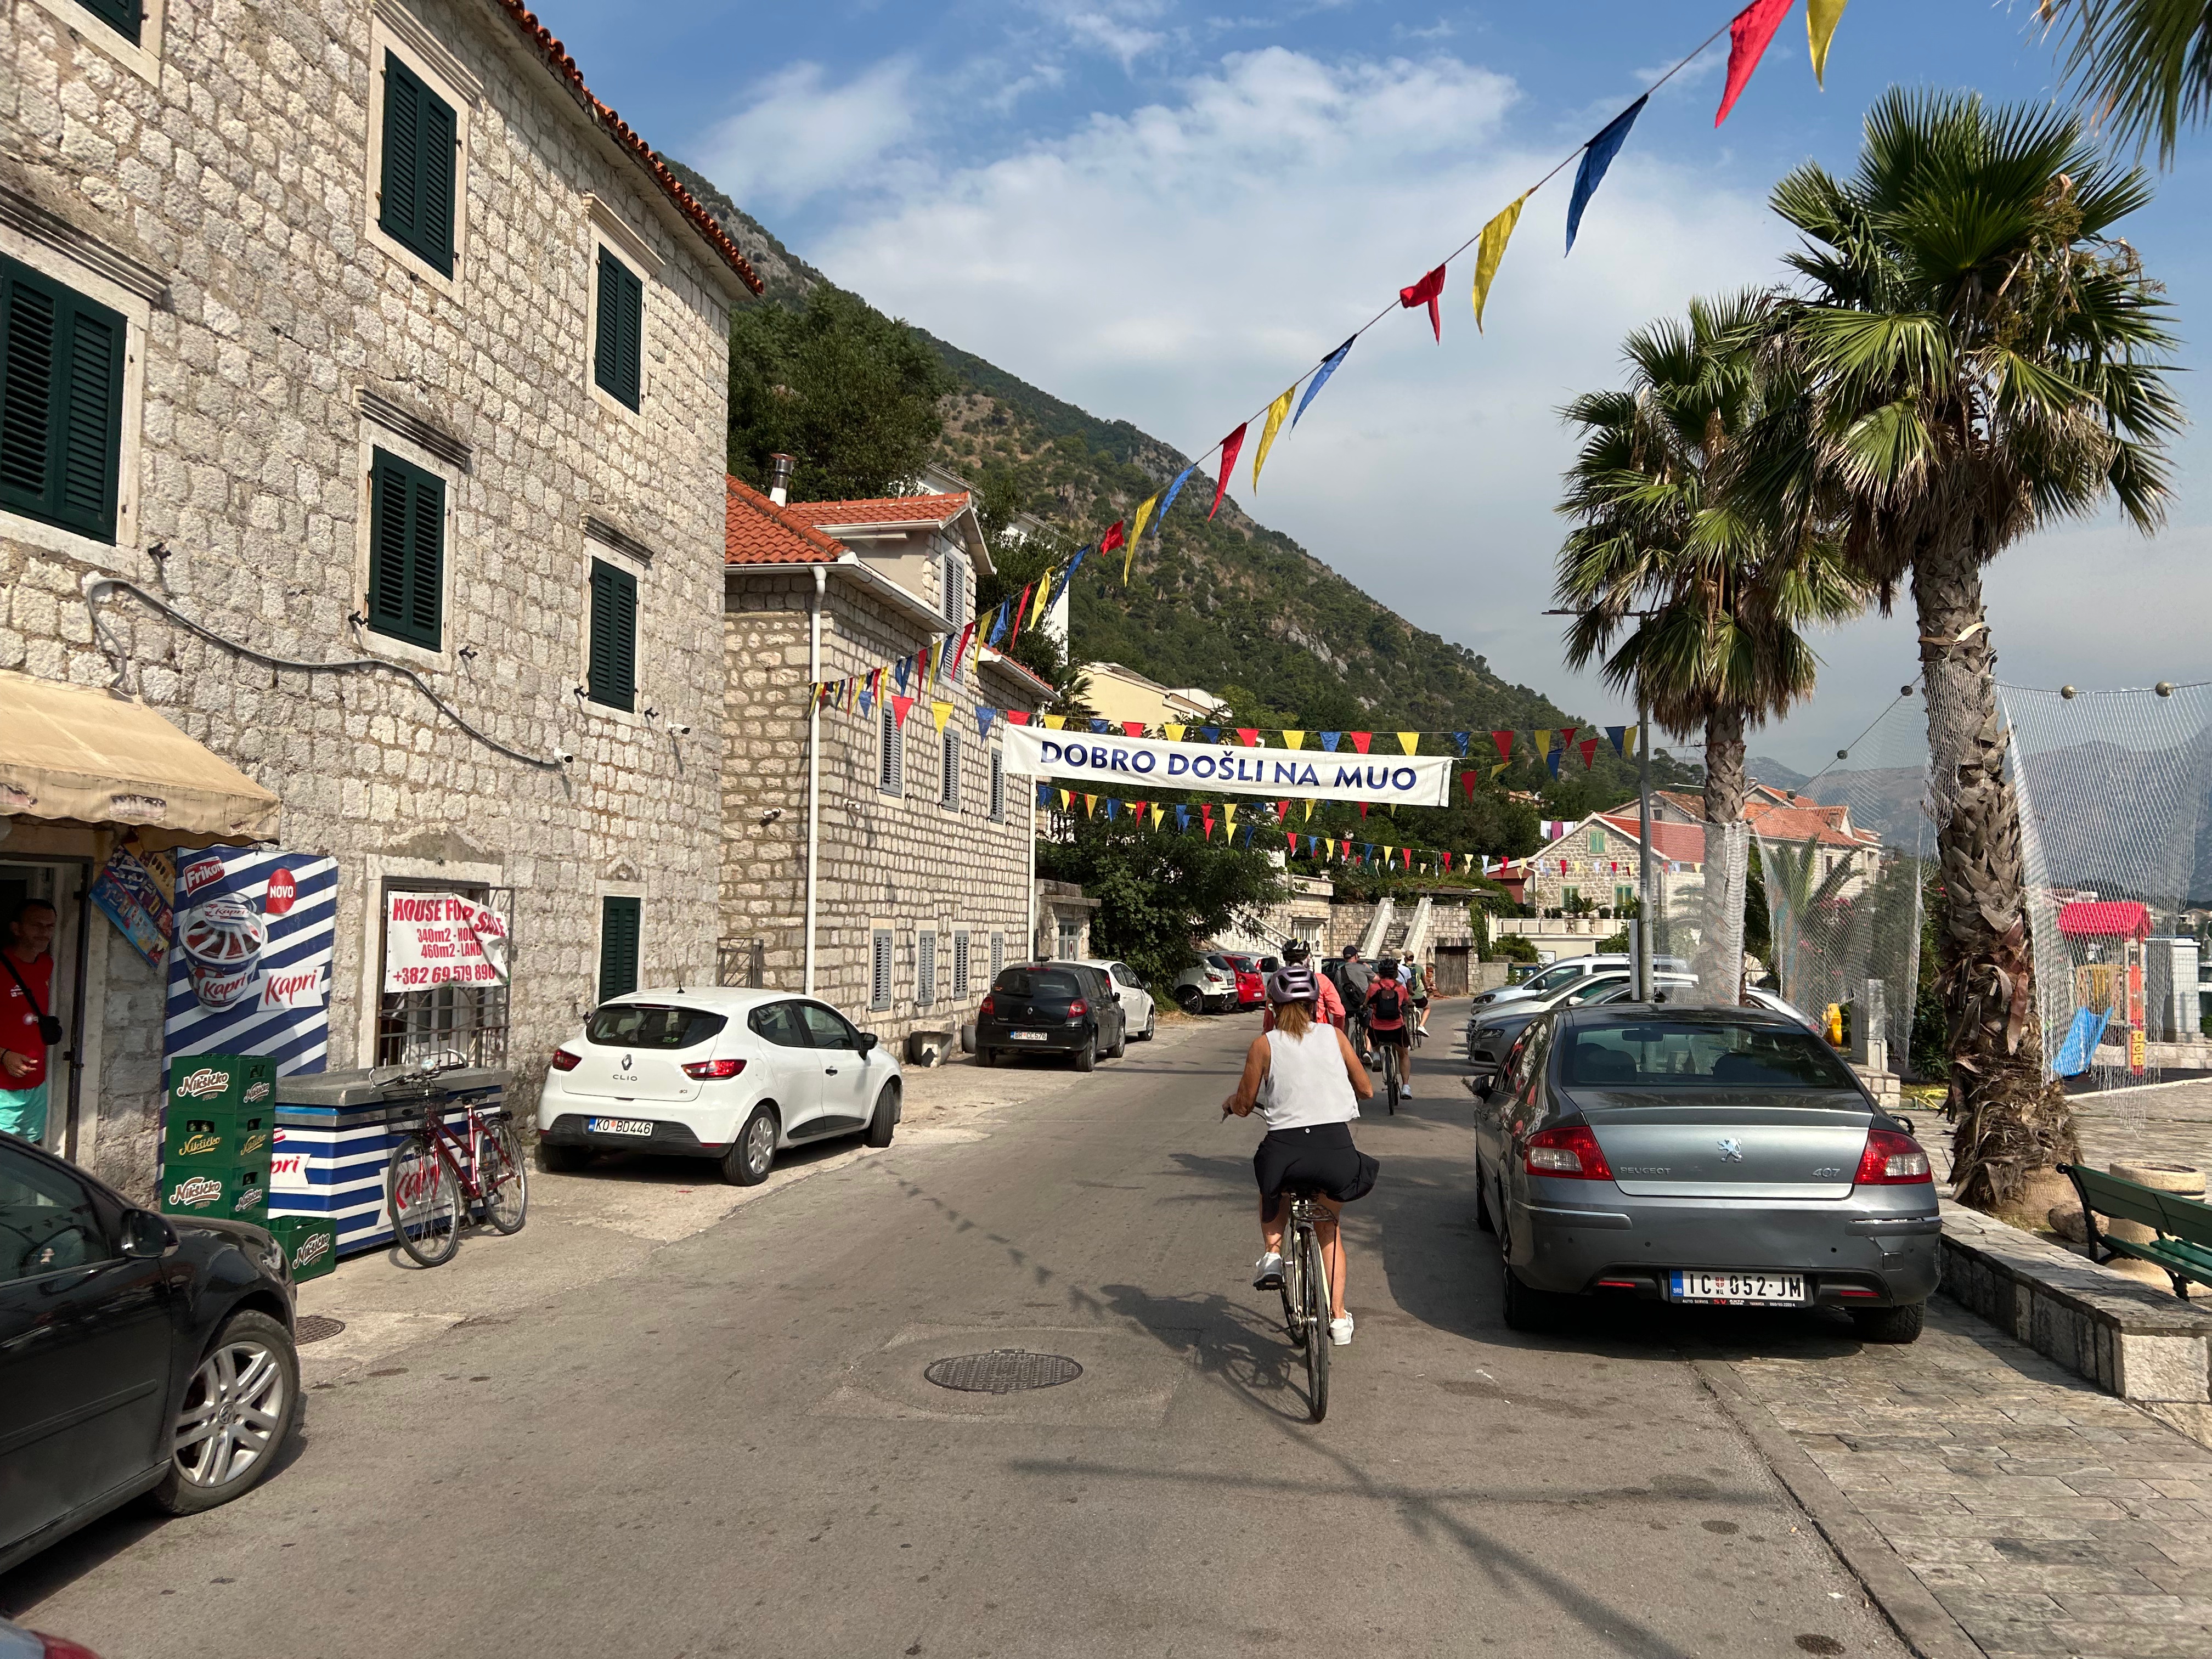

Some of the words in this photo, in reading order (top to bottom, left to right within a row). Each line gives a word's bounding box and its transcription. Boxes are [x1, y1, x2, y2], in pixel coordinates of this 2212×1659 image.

[1041, 741, 1156, 774] DOBRO
[1167, 751, 1263, 782] DOŠLI
[1274, 761, 1320, 786] NA
[1334, 765, 1417, 791] MUO
[270, 885, 294, 899] NOVO
[393, 898, 443, 922] HOUSE
[445, 899, 475, 922] FOR
[474, 911, 506, 938] SALE
[416, 928, 452, 943] 340m2
[421, 943, 455, 958] 460m2
[461, 942, 482, 957] LAND
[393, 967, 429, 985] +382
[431, 966, 450, 983] 69
[453, 965, 472, 981] 579
[475, 964, 495, 980] 890
[204, 972, 246, 1000] Kapri
[264, 969, 318, 1005] Kapri
[595, 1119, 610, 1131] KO
[616, 1120, 651, 1134] BD446
[271, 1155, 300, 1173] pri
[1620, 1167, 1671, 1175] PEUGEOT
[1812, 1167, 1841, 1178] 407
[1690, 1274, 1711, 1294] IC
